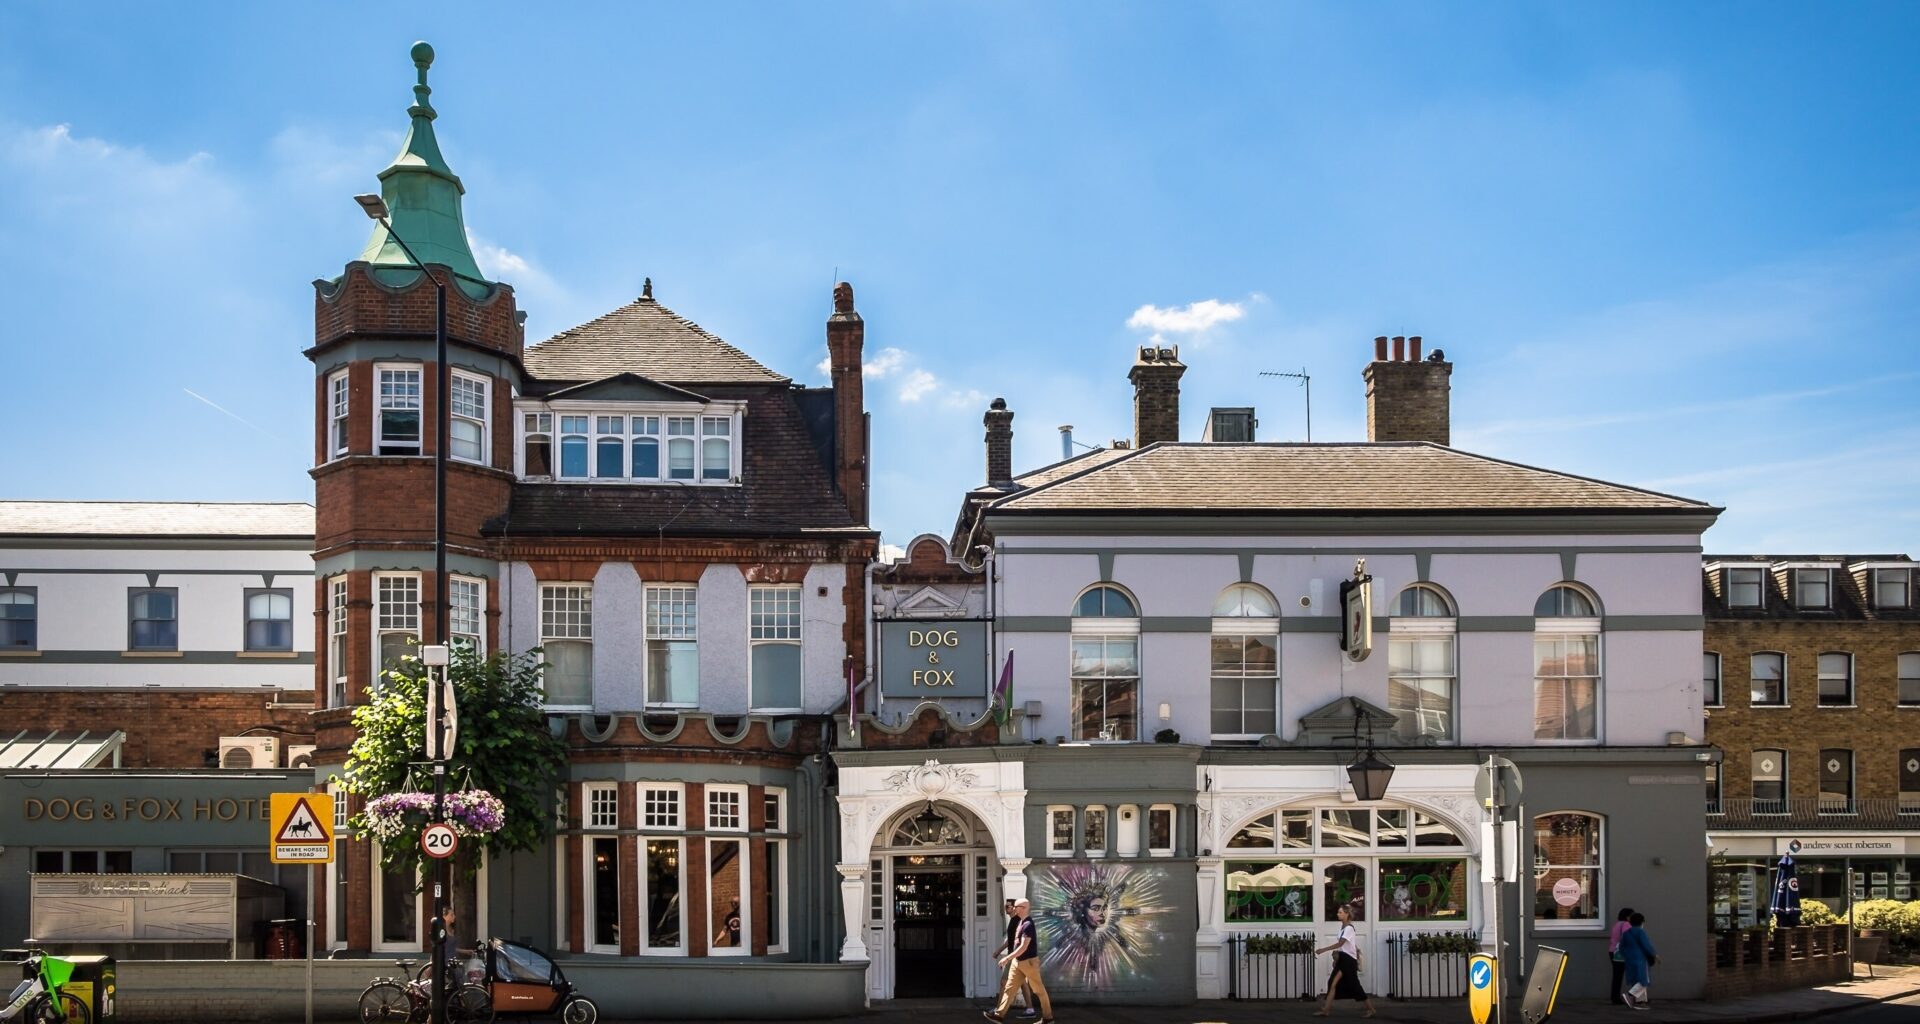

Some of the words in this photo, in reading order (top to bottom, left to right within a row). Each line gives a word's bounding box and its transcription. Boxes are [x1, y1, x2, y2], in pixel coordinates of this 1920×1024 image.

[909, 630, 958, 647] DOG
[928, 650, 939, 664] &
[913, 669, 955, 686] FOX
[24, 798, 94, 821] DOG
[101, 802, 116, 820] &
[122, 798, 181, 821] FOX
[192, 798, 271, 821] HOTE
[427, 833, 453, 848] 20
[1803, 841, 1831, 849] andrew
[1834, 841, 1852, 849] scott
[1855, 841, 1892, 849] robertson
[78, 881, 150, 895] BURGER
[1384, 873, 1457, 906] FOX
